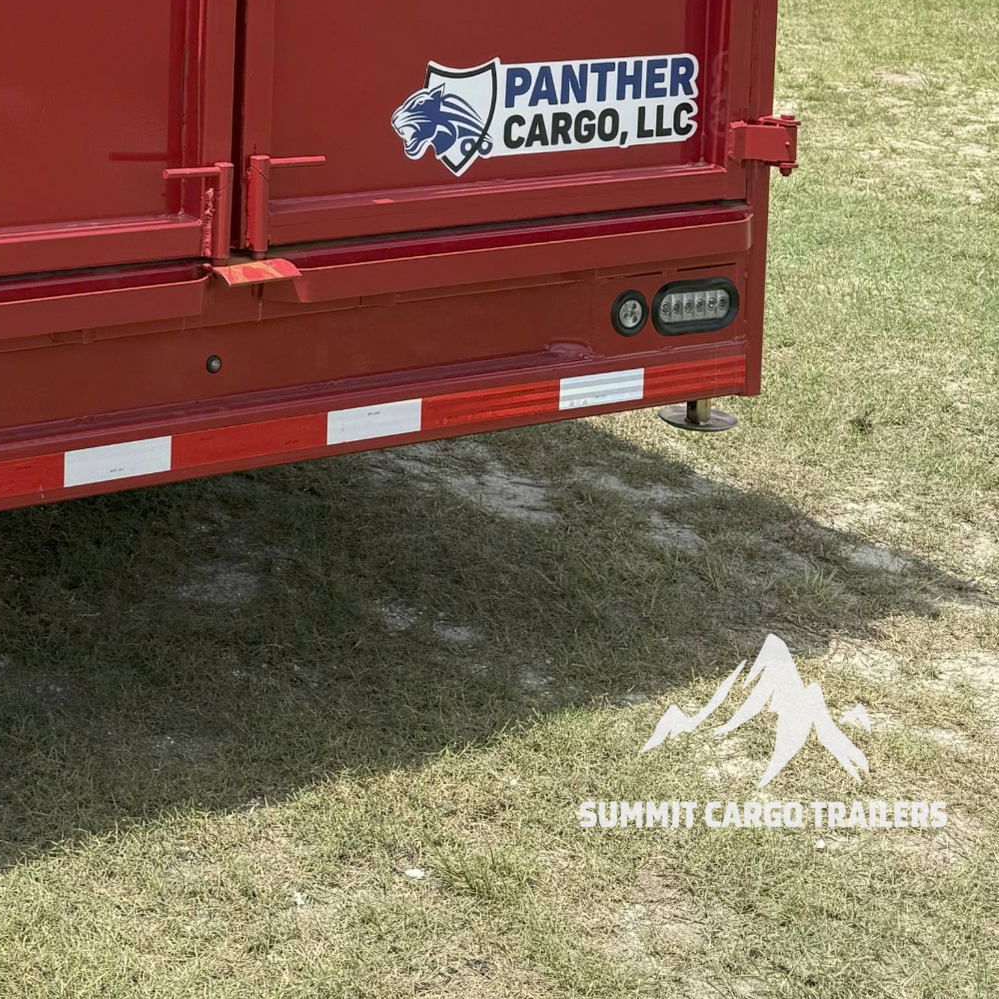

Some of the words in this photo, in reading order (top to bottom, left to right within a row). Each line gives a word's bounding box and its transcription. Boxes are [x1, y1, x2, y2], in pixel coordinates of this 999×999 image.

[504, 57, 695, 109] PANTHER
[502, 107, 629, 149] CARGO,
[636, 102, 694, 139] LLC
